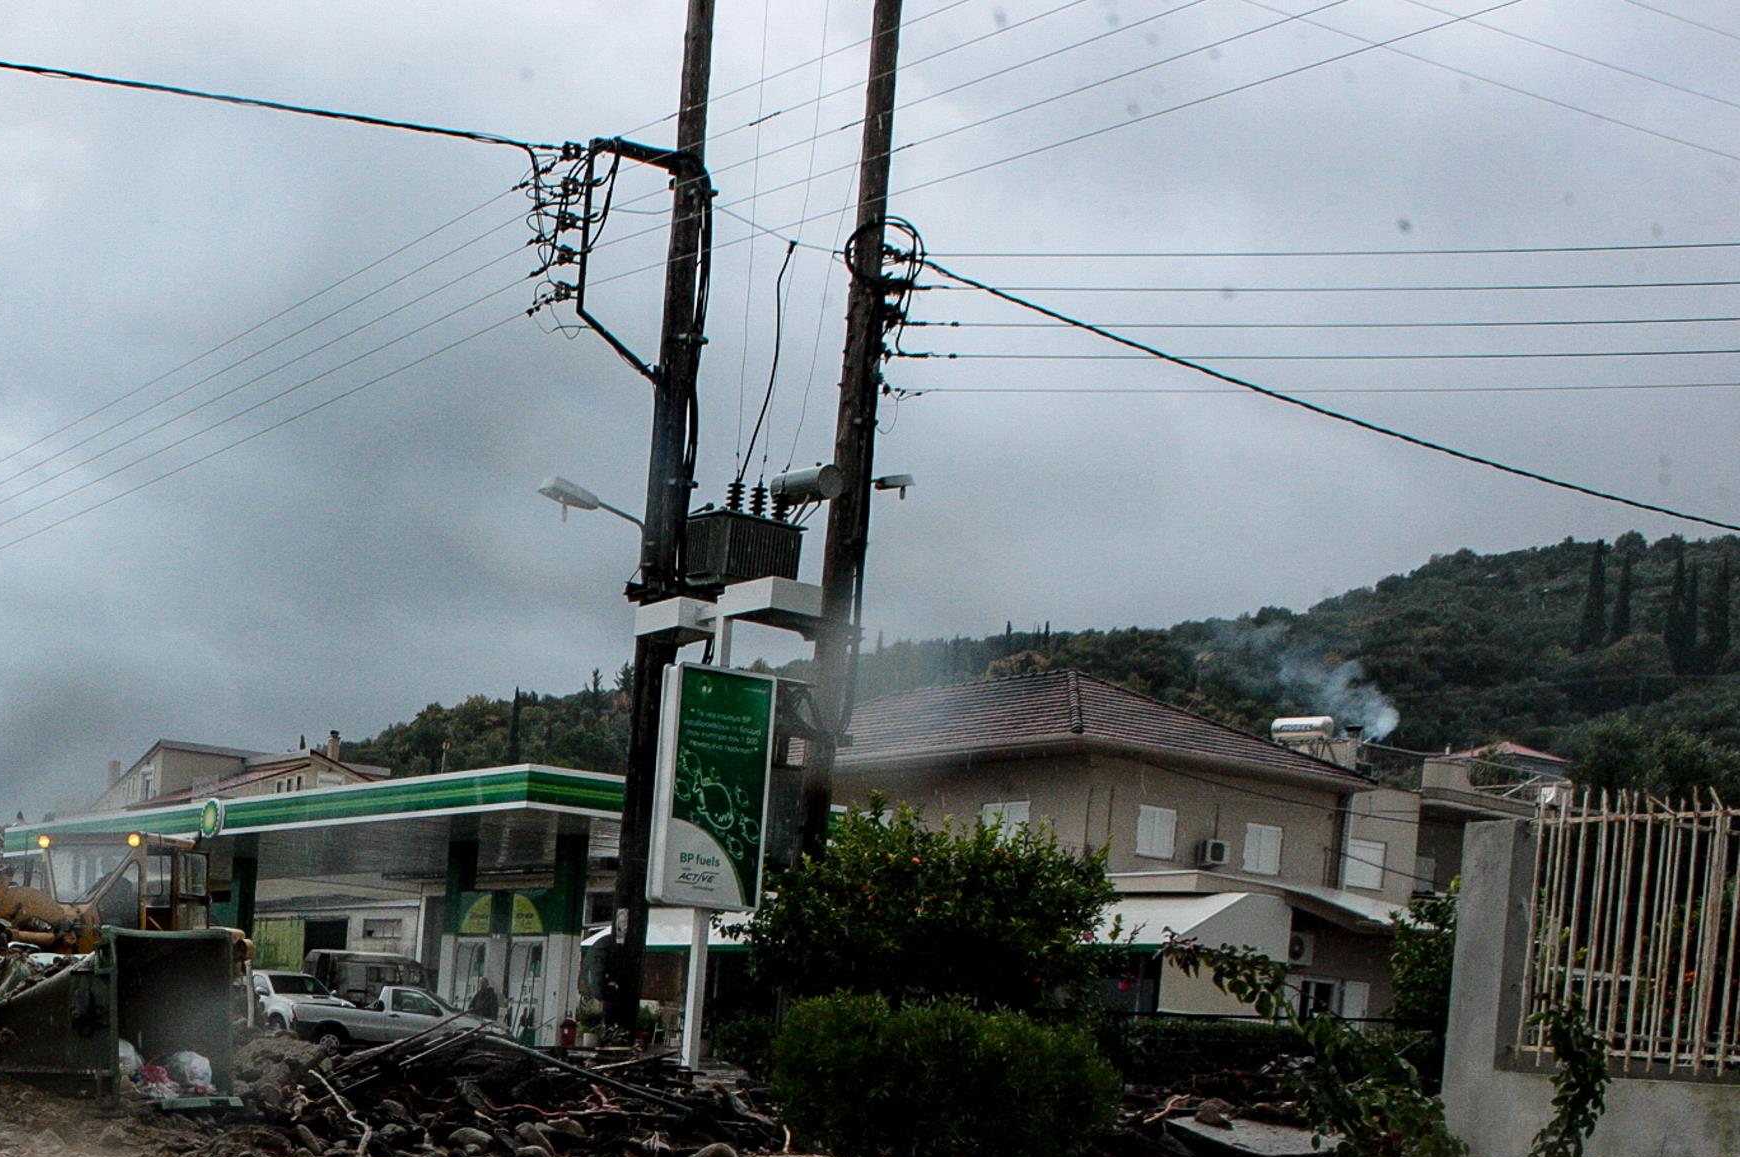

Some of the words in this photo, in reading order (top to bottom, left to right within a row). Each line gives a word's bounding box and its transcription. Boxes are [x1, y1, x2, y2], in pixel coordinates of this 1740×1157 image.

[680, 852, 694, 864] BP
[696, 854, 720, 868] fuels
[677, 871, 717, 884] ACTIVE
